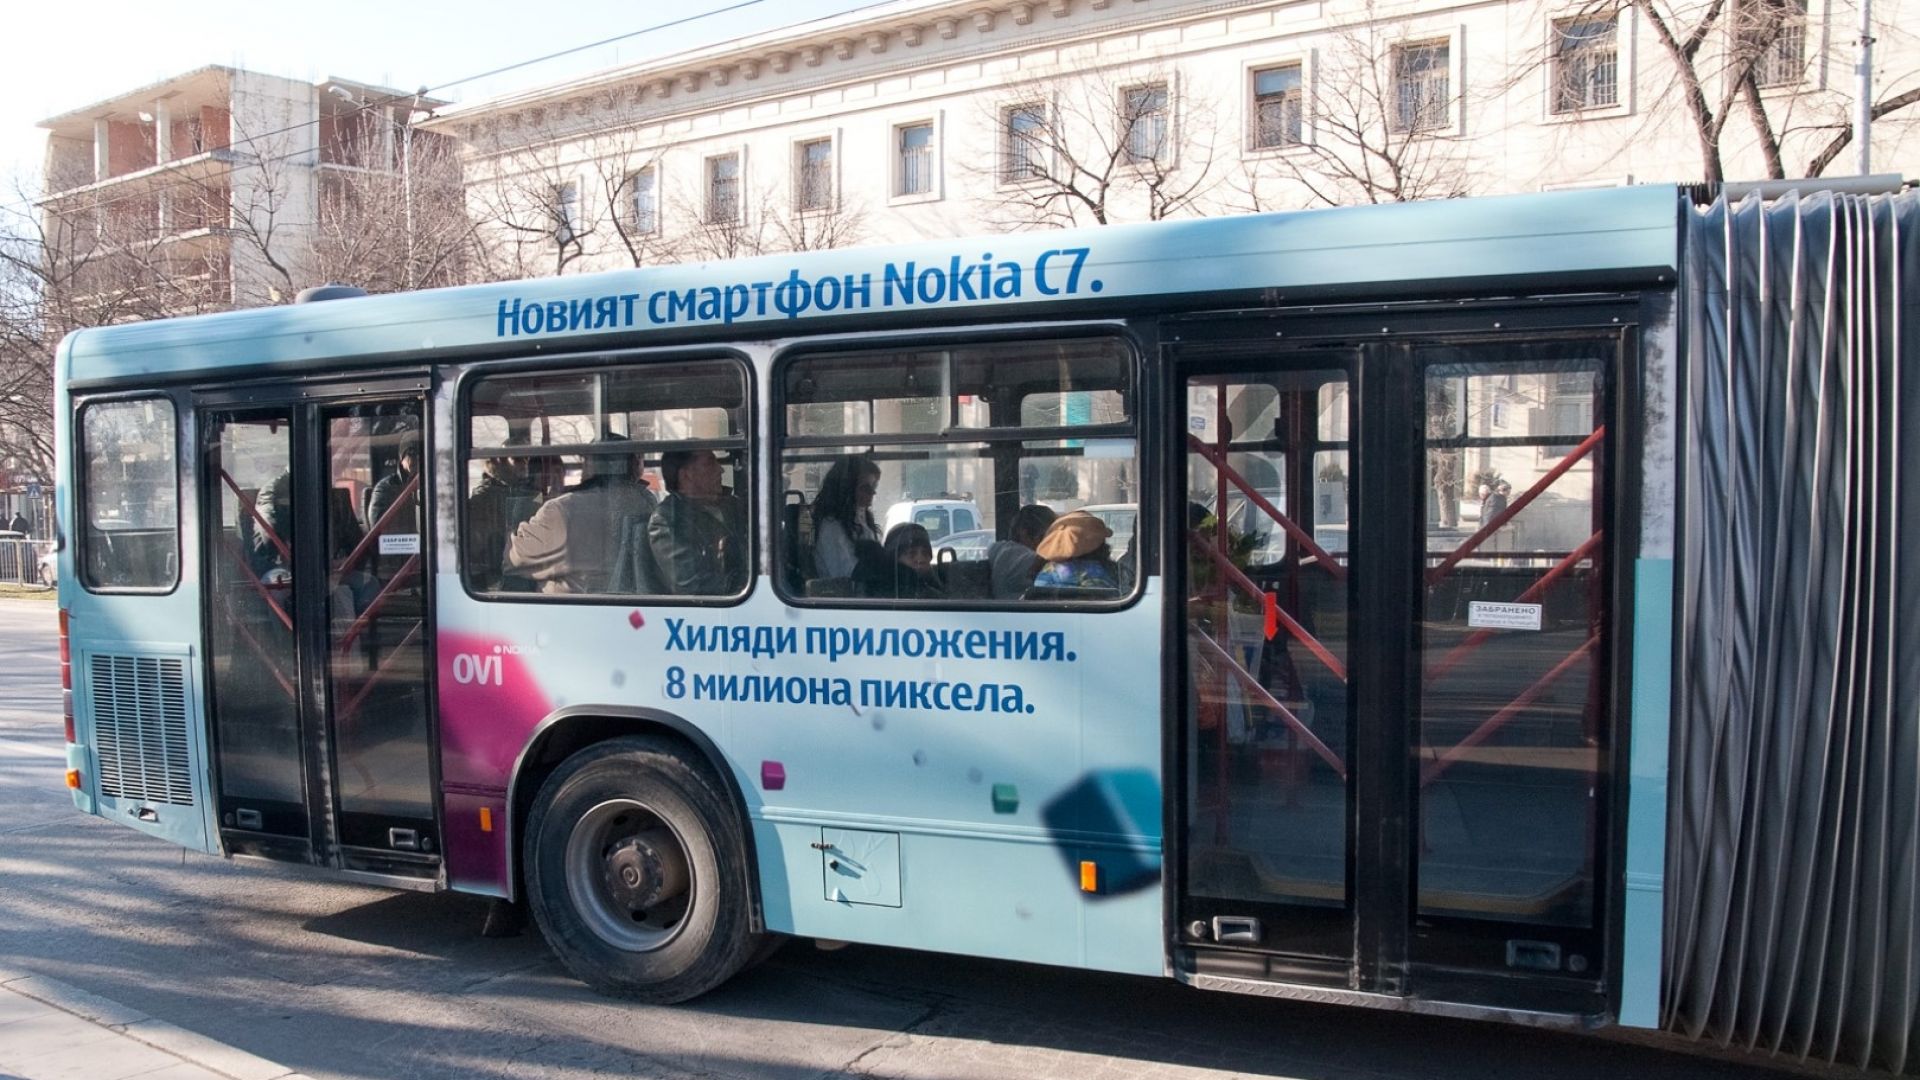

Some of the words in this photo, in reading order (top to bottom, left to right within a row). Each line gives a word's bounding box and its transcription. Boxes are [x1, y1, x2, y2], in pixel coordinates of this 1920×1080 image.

[497, 293, 641, 337] Новият
[648, 268, 871, 327] смартфон
[884, 252, 1022, 307] Nokia
[1034, 247, 1104, 297] C7.
[1475, 605, 1536, 615] ЗАБРАНЕНО
[665, 618, 798, 661] Хиляди
[806, 626, 1078, 664] приложения.
[665, 666, 686, 699] 8
[693, 674, 851, 707] милиона
[860, 679, 1035, 715] пиксела.
